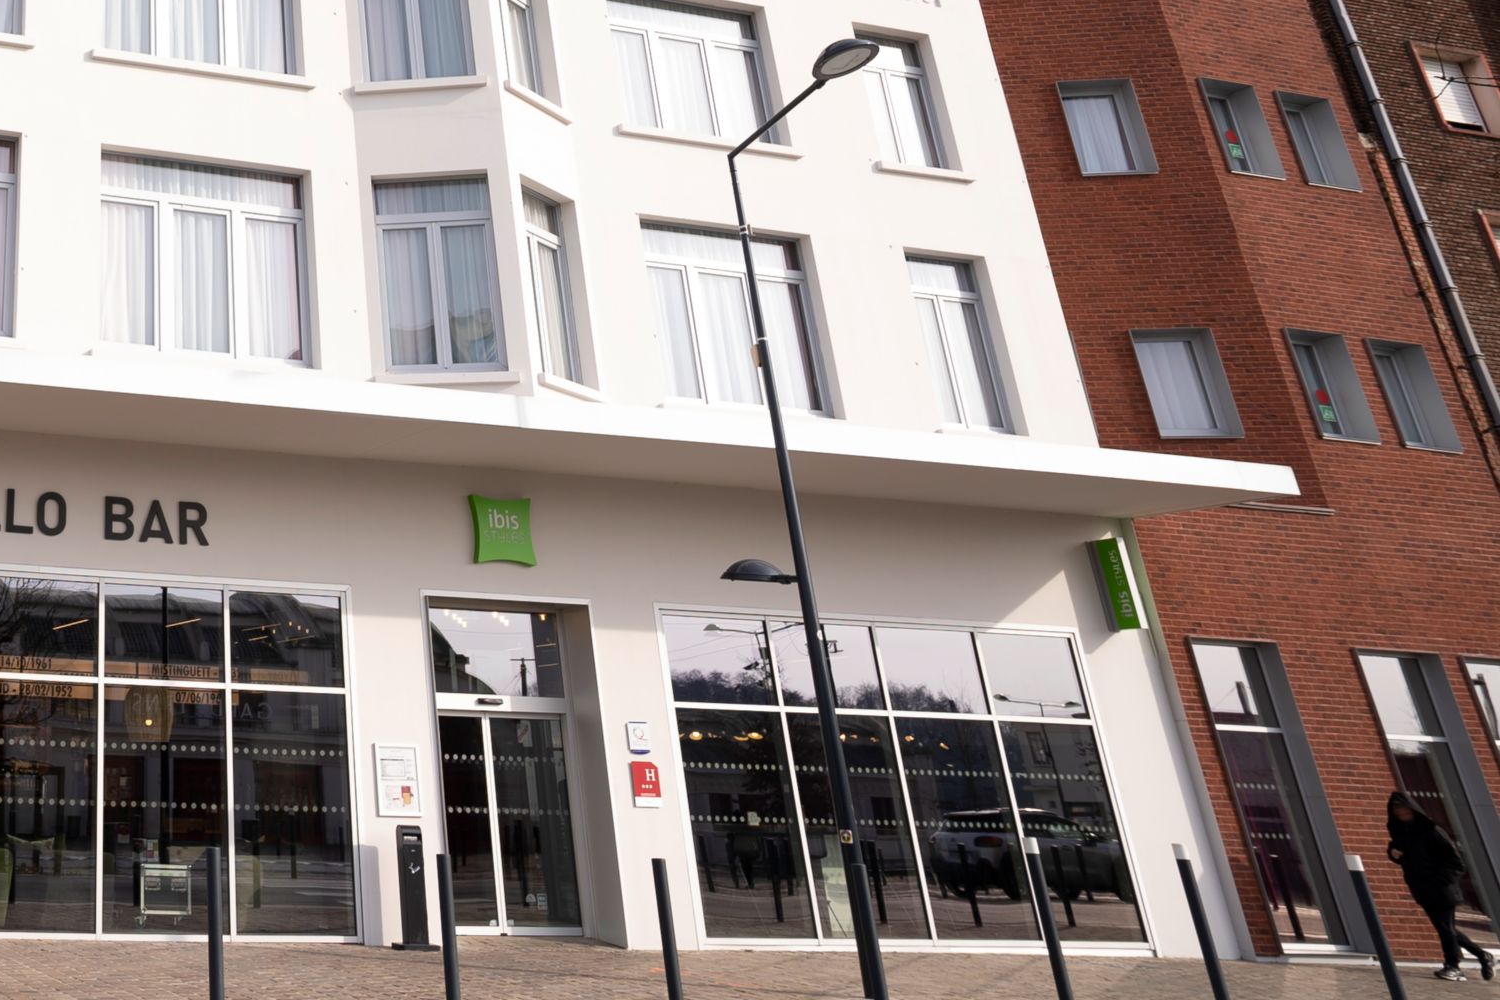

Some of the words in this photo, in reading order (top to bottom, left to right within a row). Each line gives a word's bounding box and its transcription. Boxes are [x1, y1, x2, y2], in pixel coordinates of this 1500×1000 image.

[104, 495, 210, 546] BAR
[488, 509, 519, 529] ibis
[1119, 591, 1132, 616] ibis
[20, 684, 73, 697] 28/02/1952
[645, 769, 656, 781] H
